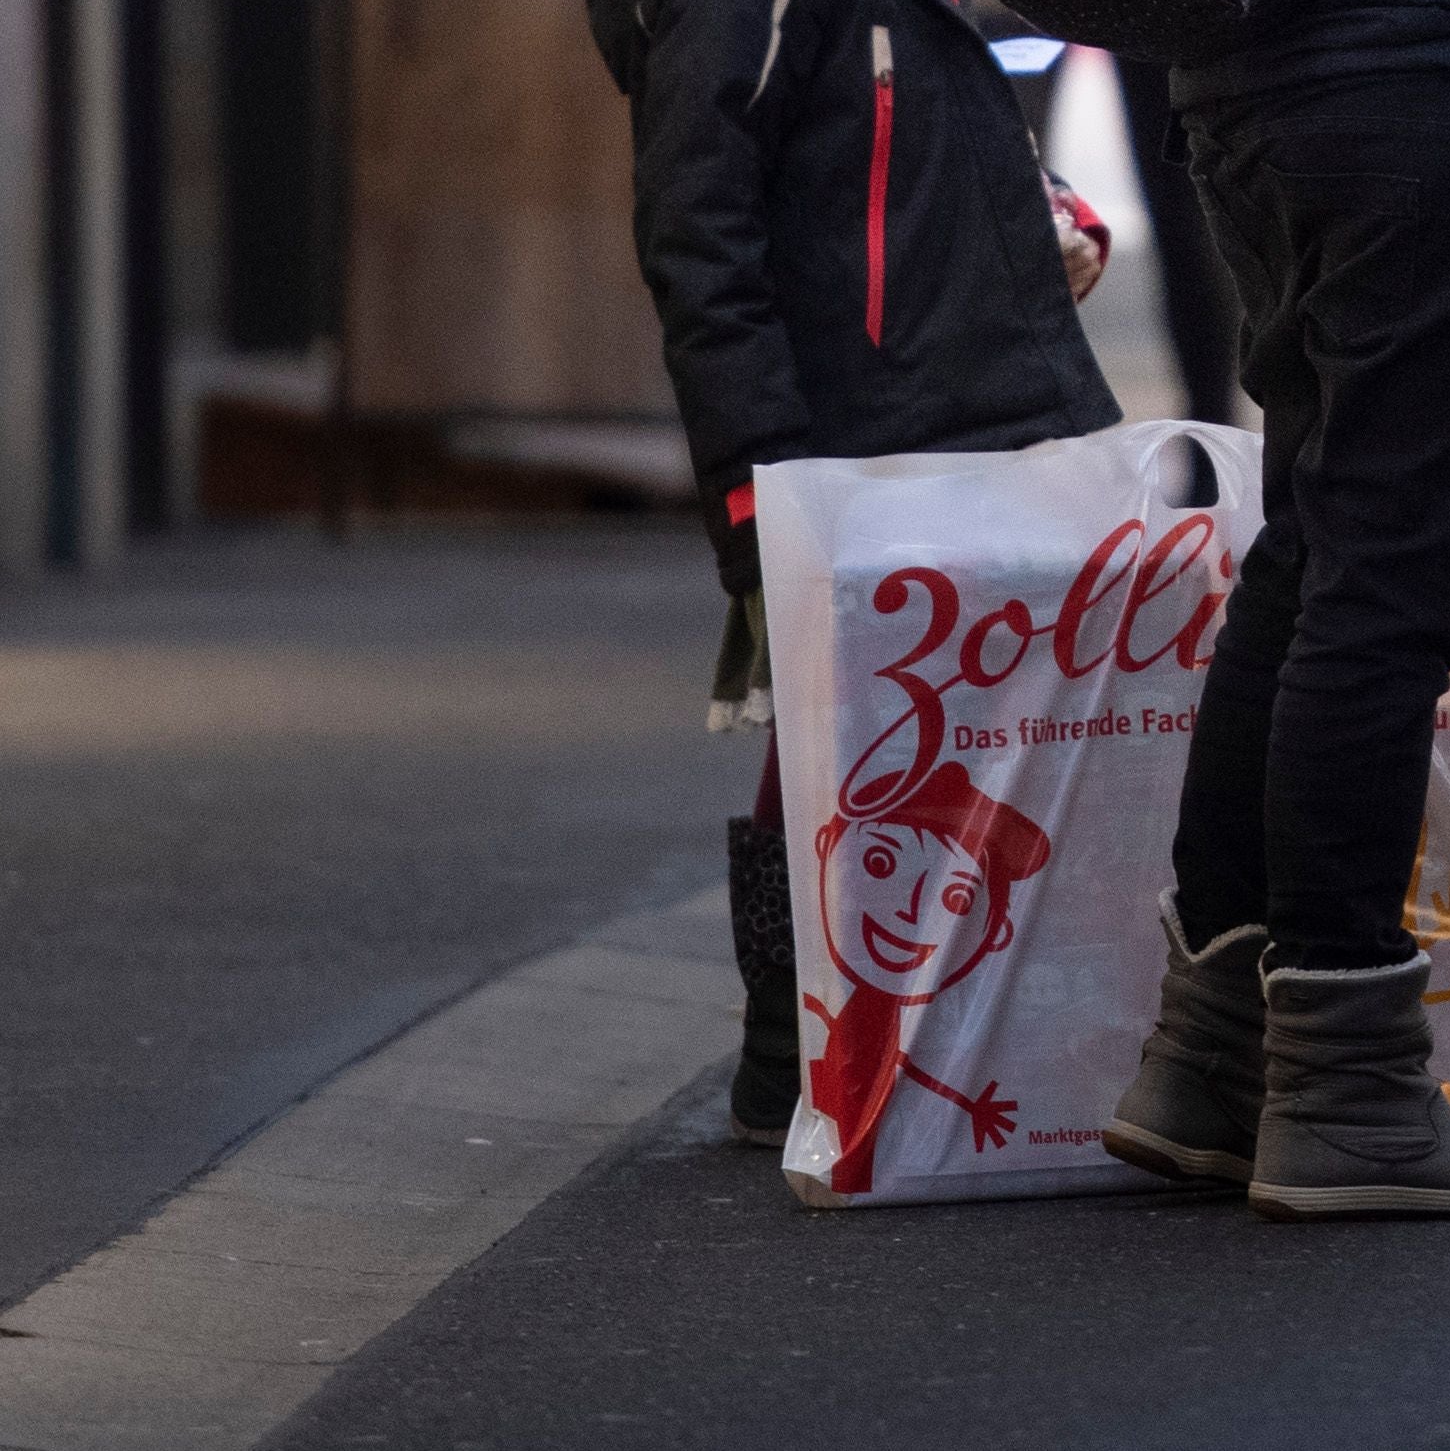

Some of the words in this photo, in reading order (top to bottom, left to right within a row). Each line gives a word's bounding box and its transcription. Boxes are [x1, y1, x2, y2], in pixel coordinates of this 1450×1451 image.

[954, 725, 1008, 751] Das
[1018, 708, 1132, 746] führende
[1028, 1127, 1105, 1147] Marktgas
